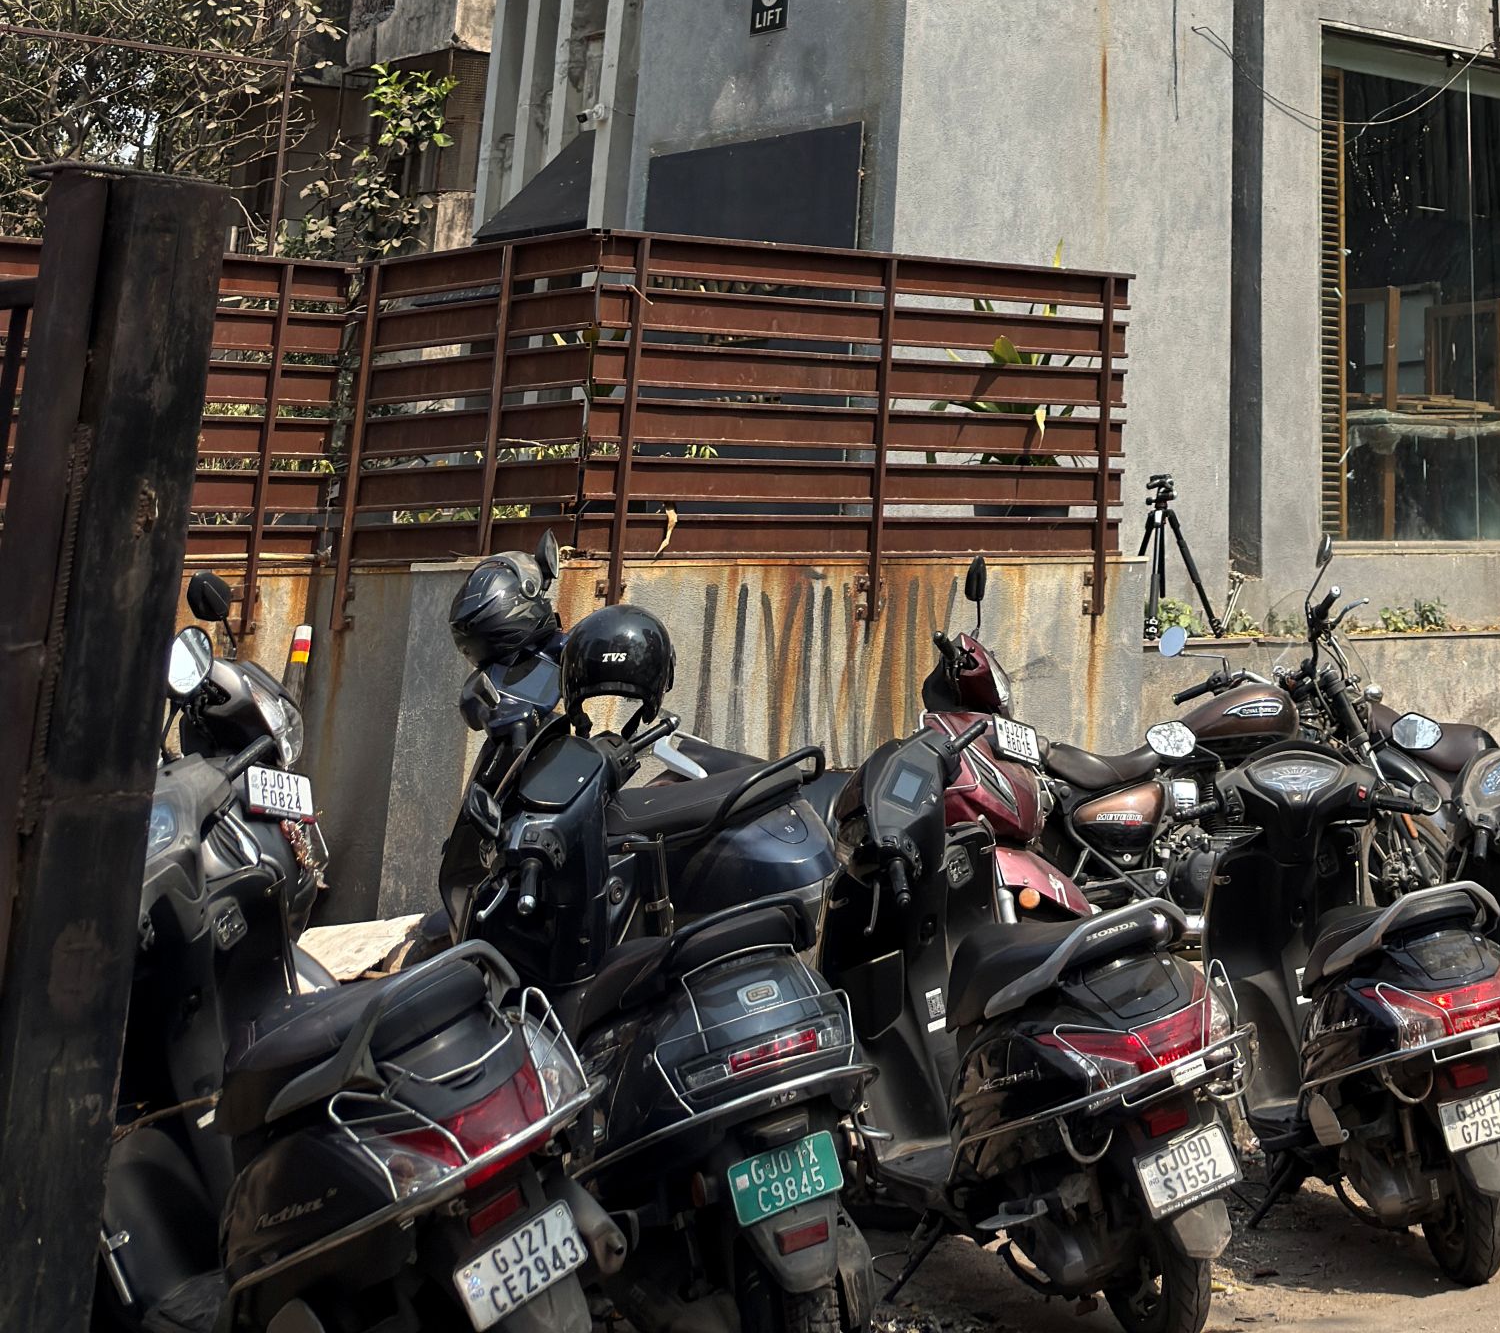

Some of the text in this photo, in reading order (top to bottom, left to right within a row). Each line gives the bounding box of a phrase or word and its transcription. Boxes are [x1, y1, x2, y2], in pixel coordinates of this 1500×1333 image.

[755, 8, 782, 28] LIFT
[602, 652, 627, 663] TVS
[261, 770, 299, 794] GJ01Y
[262, 789, 301, 811] F0824
[1086, 921, 1139, 941] HONDA
[751, 1140, 818, 1185] GJ01X
[1155, 1136, 1211, 1176] GJ09D
[758, 1166, 825, 1212] C9845
[1163, 1158, 1221, 1199] S1552
[492, 1219, 547, 1274] GJ27
[490, 1237, 579, 1312] CE2943
